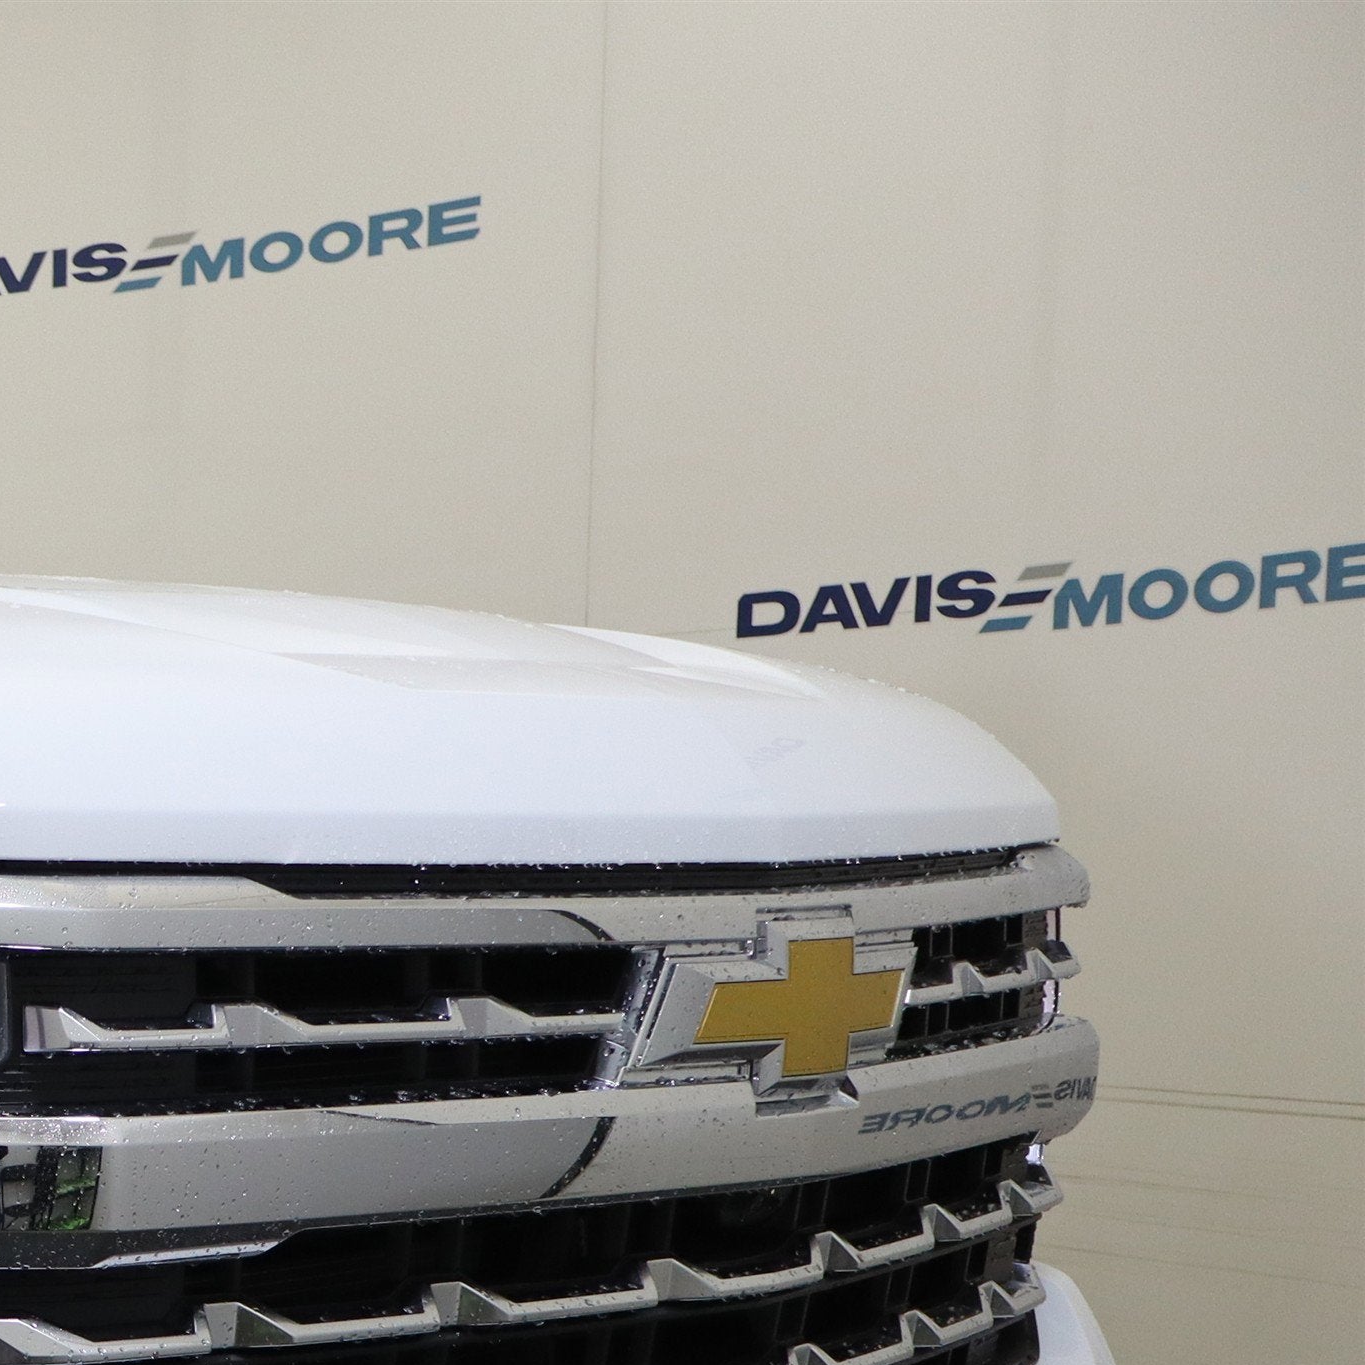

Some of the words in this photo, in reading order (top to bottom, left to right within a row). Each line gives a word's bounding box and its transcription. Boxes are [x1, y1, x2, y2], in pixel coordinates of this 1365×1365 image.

[180, 195, 482, 287] MOORE
[735, 569, 997, 640] DAVIS
[1052, 542, 1365, 631] MOORE
